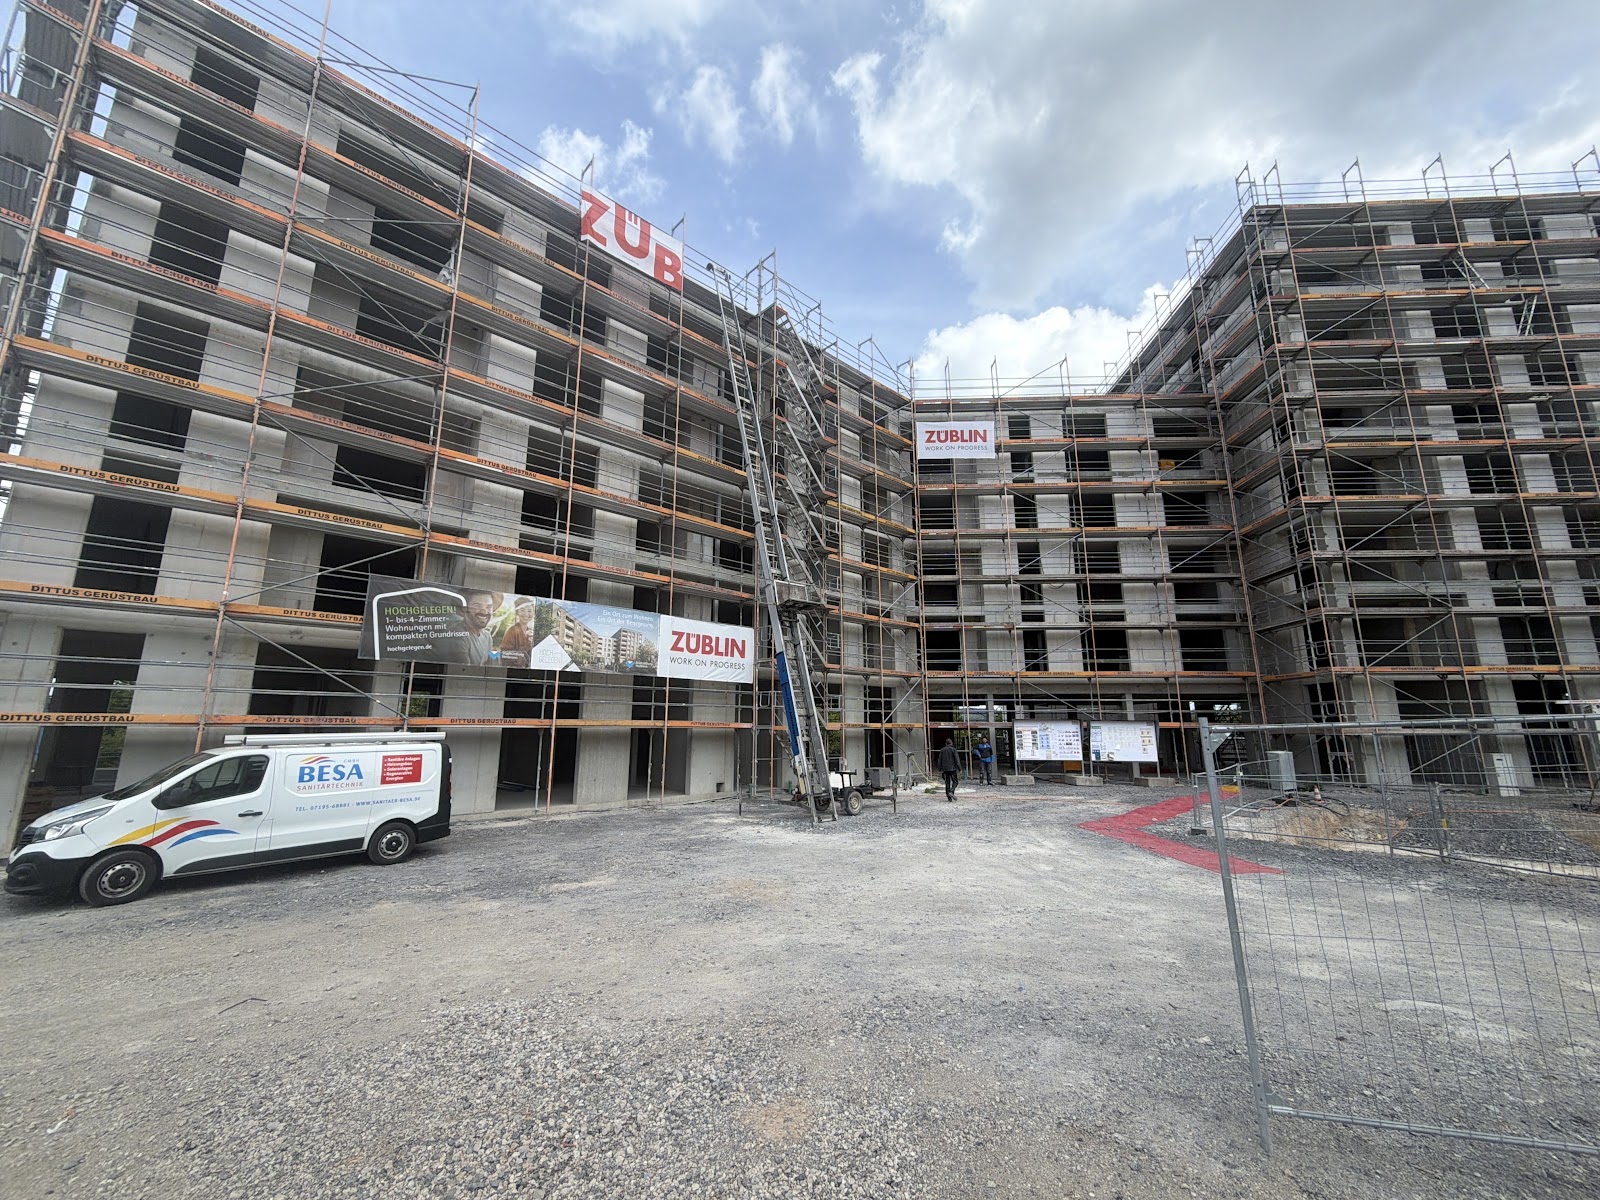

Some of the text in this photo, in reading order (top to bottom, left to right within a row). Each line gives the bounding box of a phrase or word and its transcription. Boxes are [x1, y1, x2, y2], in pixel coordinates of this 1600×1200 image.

[156, 66, 194, 88] DITTUS
[353, 163, 381, 179] DITTUS
[581, 190, 682, 291] ZÜB
[340, 241, 368, 257] DITTUS
[111, 251, 153, 269] DITTUS
[491, 305, 514, 319] DITTUS
[327, 325, 357, 340] DITTUS
[86, 354, 200, 389] DITTUS GERÜSTBAU
[925, 429, 987, 443] ZÜBLIN
[477, 458, 537, 478] DITTUS GERÜSTBAU
[60, 465, 180, 493] DITTUS GERÜSTBAU
[297, 508, 383, 529] DITTUS GERÜSTBAU
[31, 585, 158, 603] DITTUS GERÜSTBAU
[283, 609, 364, 622] DITTUS GERÜSTBA
[385, 606, 457, 615] HOCHGELEGEN!
[385, 624, 432, 632] Wohnungen
[385, 631, 469, 641] kompakten Grundrissen
[387, 644, 433, 652] hochgelegen.de
[670, 630, 746, 659] ZÜBLIN
[669, 656, 746, 671] WORK ON PROGRESS
[0, 713, 135, 723] DITTUS GERÜSTBAU
[298, 764, 364, 783] BESA
[297, 781, 364, 791] SANITÄRTECHNIK
